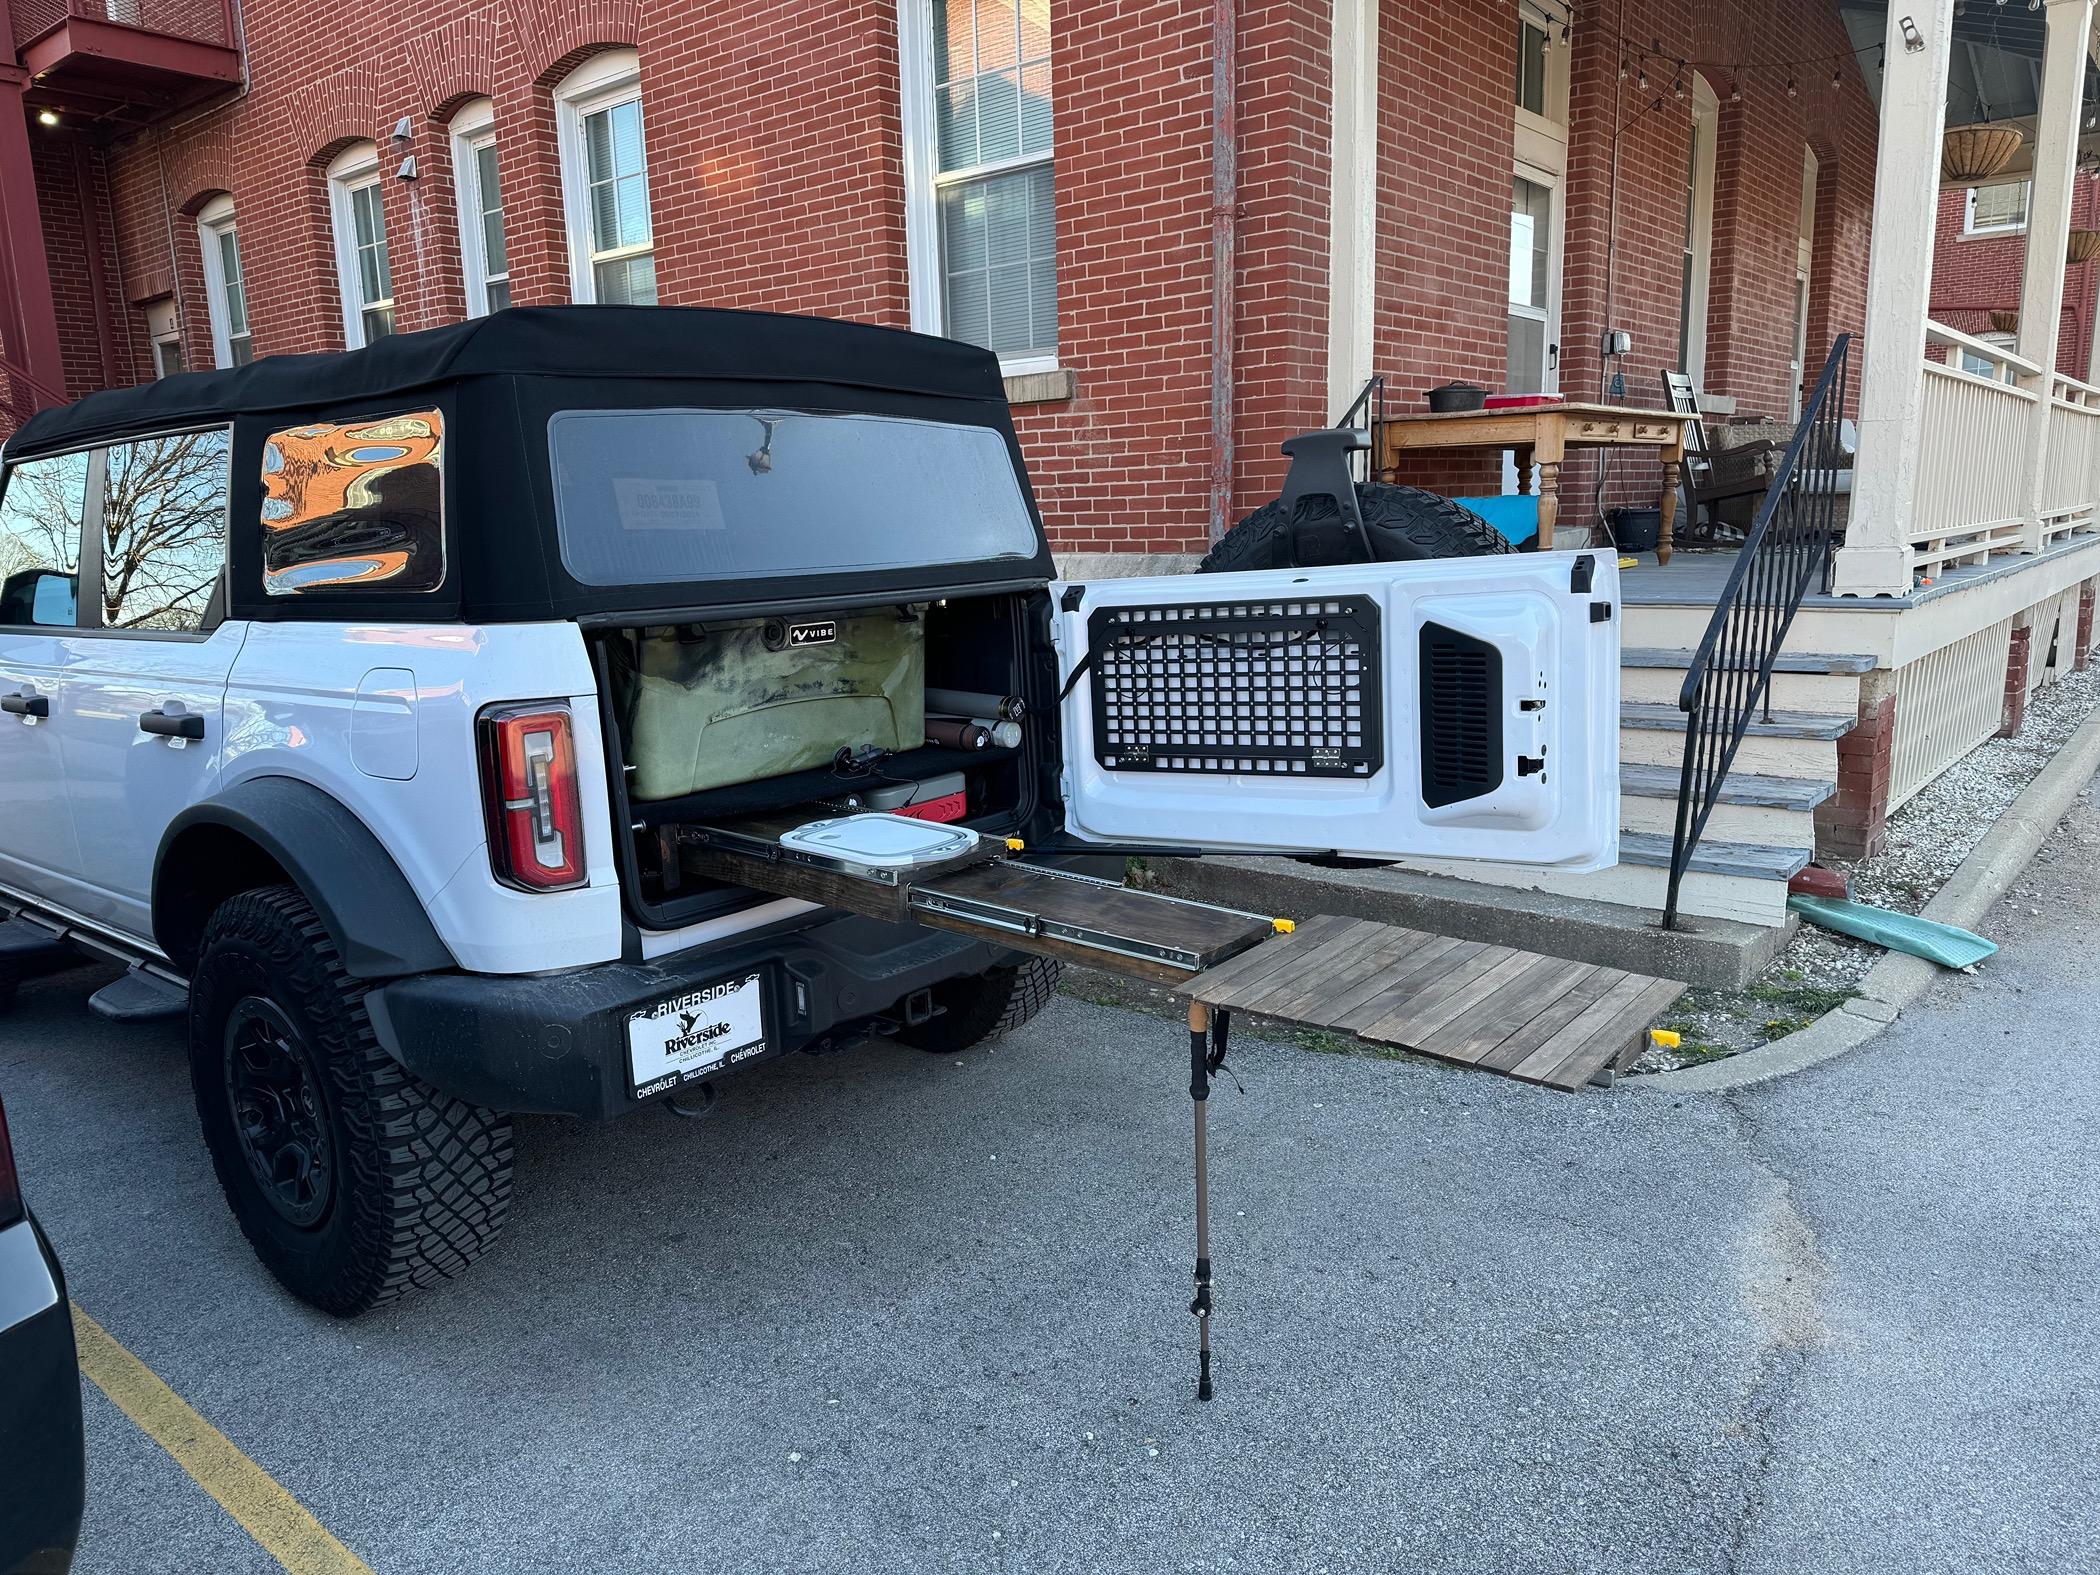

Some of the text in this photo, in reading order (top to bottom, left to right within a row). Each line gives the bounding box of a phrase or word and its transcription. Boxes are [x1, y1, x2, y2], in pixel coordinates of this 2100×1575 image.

[809, 628, 834, 638] VIBE
[657, 981, 735, 1018] RIVERSIDE
[664, 1021, 731, 1056] Riverside
[730, 1042, 766, 1064] CHEVROLET
[683, 1063, 719, 1082] CHILLICOTHE,
[636, 1076, 677, 1099] CHEVROLET
